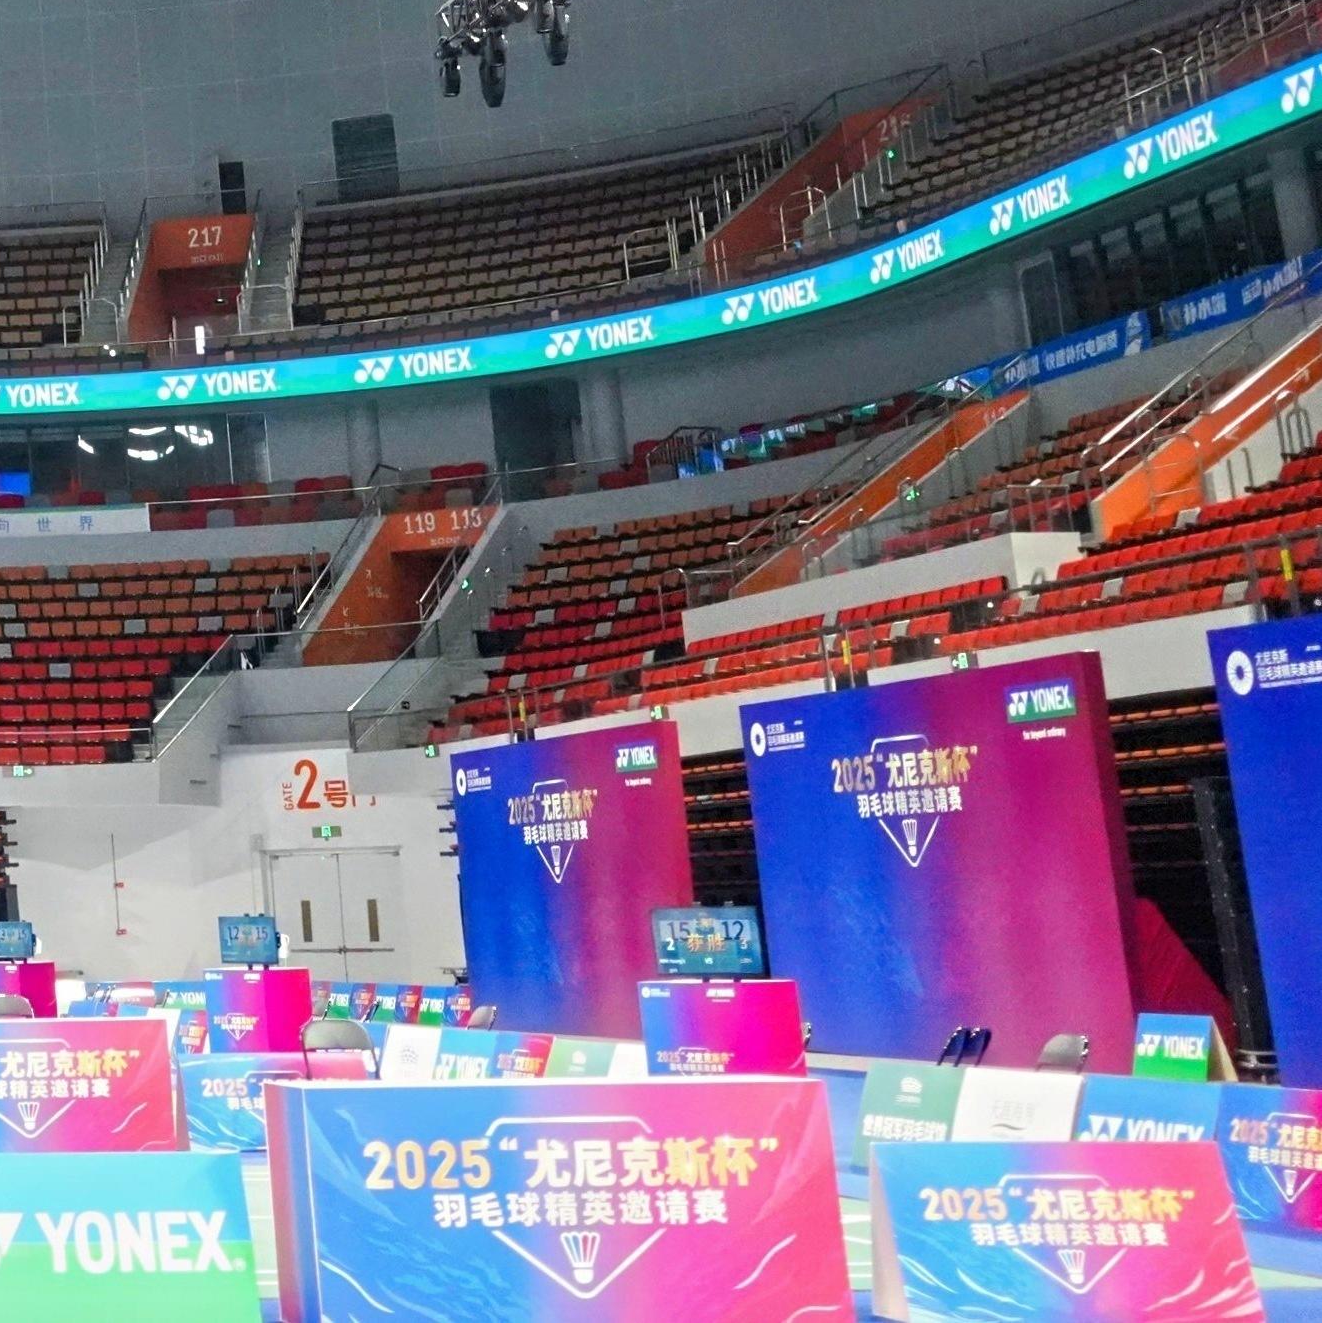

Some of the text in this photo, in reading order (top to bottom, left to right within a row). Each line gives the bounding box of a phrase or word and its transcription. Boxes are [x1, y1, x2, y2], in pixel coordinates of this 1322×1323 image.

[1156, 111, 1218, 165] YONEX
[1017, 176, 1070, 222] YONEX
[188, 226, 222, 248] 217
[897, 229, 945, 274] YONEX
[759, 276, 818, 316] YONEX
[586, 316, 653, 351] YONEX
[400, 346, 473, 378] YONEX
[6, 381, 81, 407] YONEX
[203, 368, 277, 396] YONEX
[404, 512, 435, 535] 119
[1030, 683, 1072, 713] YONEX
[630, 745, 655, 766] YONEX
[282, 782, 295, 811] GATE
[857, 786, 963, 819] 羽毛球精英邀请赛
[666, 937, 675, 951] 2
[721, 920, 744, 941] 12
[181, 991, 205, 1004] YON
[1161, 1032, 1205, 1060] YONEX
[433, 1189, 729, 1228] 羽毛球精英邀请赛
[34, 1210, 233, 1275] YONEX
[970, 1222, 1169, 1248] 羽毛球精英邀请赛
